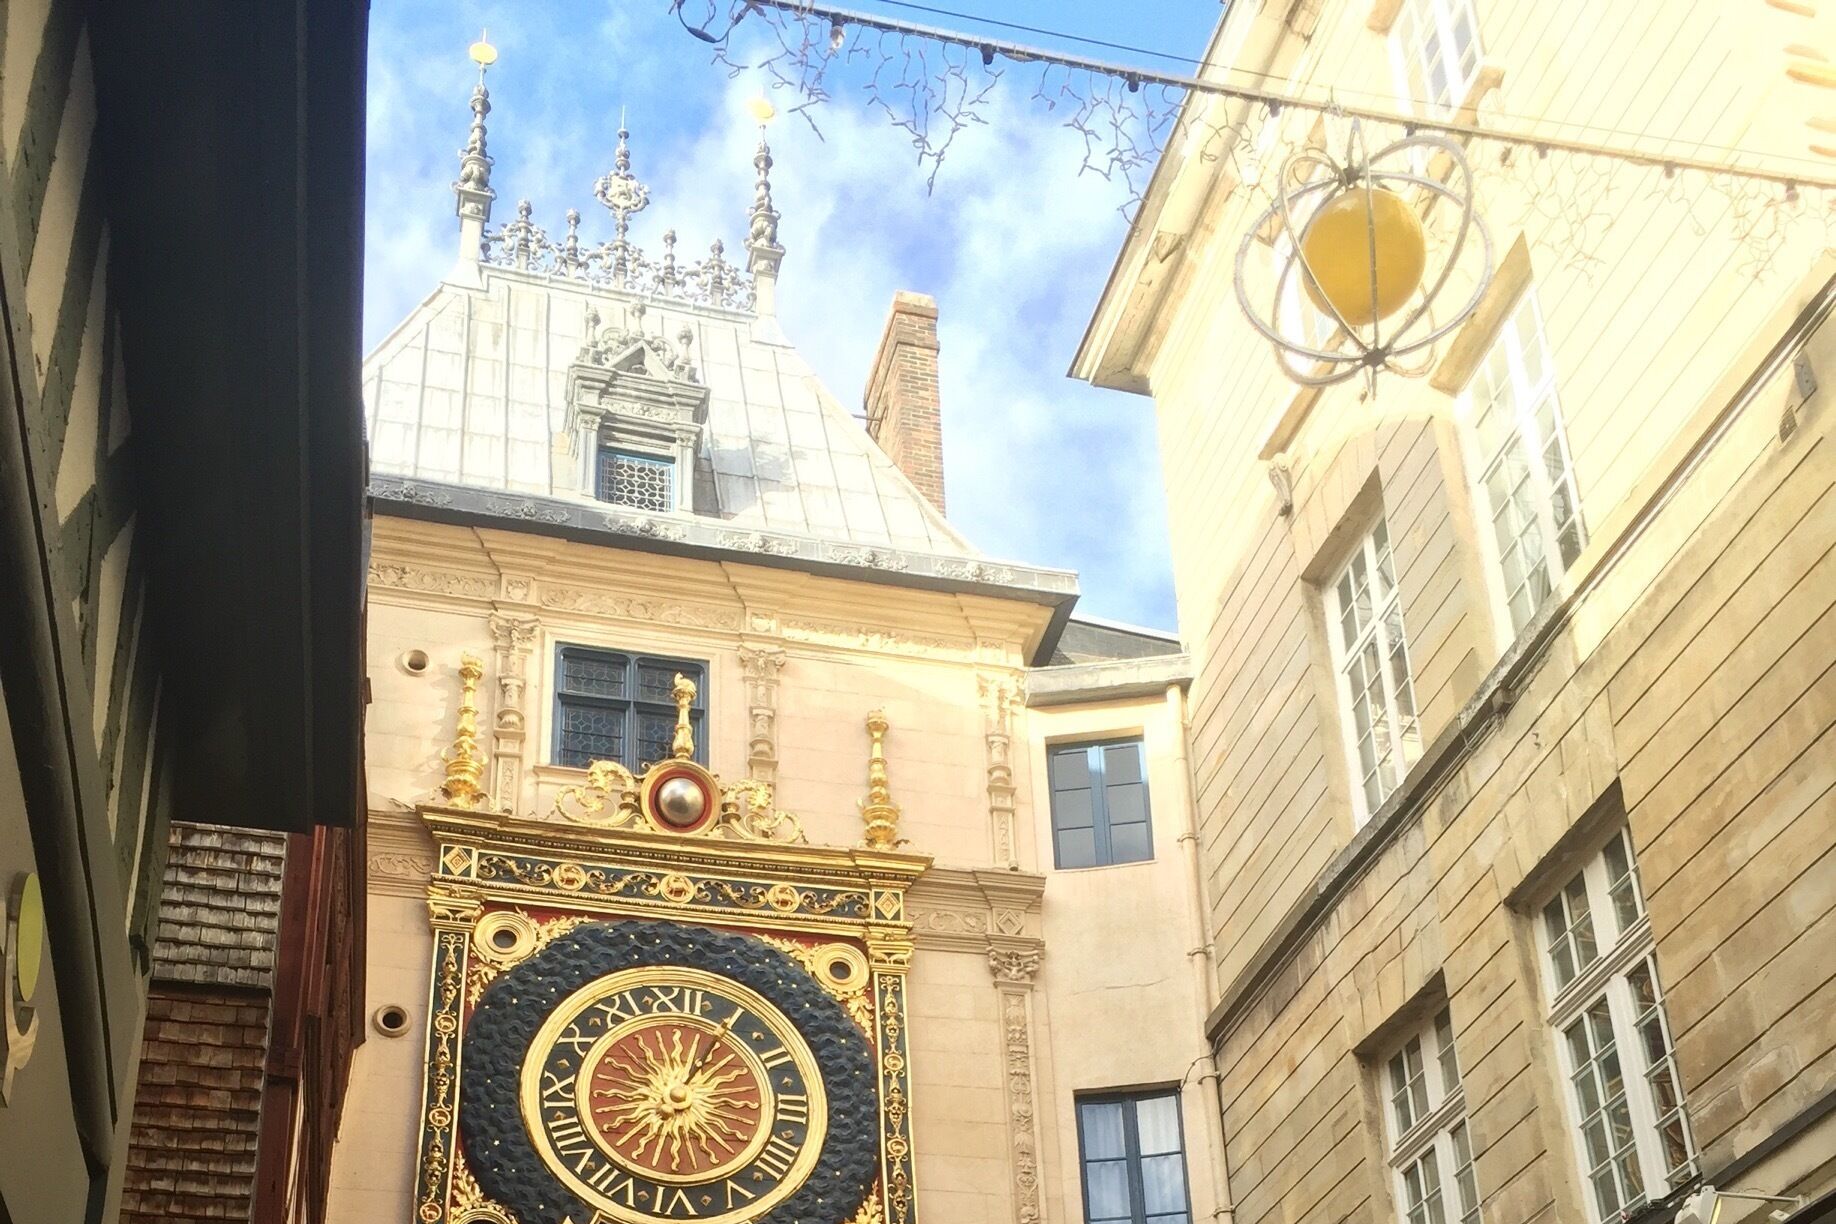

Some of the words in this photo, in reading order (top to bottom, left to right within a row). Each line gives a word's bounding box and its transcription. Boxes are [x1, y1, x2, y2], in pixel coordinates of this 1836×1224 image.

[595, 992, 643, 1029] XI
[650, 987, 704, 1016] XII
[559, 1024, 597, 1057] X
[762, 1046, 793, 1070] II
[543, 1070, 575, 1109] IX
[777, 1093, 807, 1125] III
[548, 1117, 589, 1175] VIII
[587, 1168, 637, 1209] VII
[653, 1185, 698, 1216] VI
[725, 1178, 756, 1209] V
